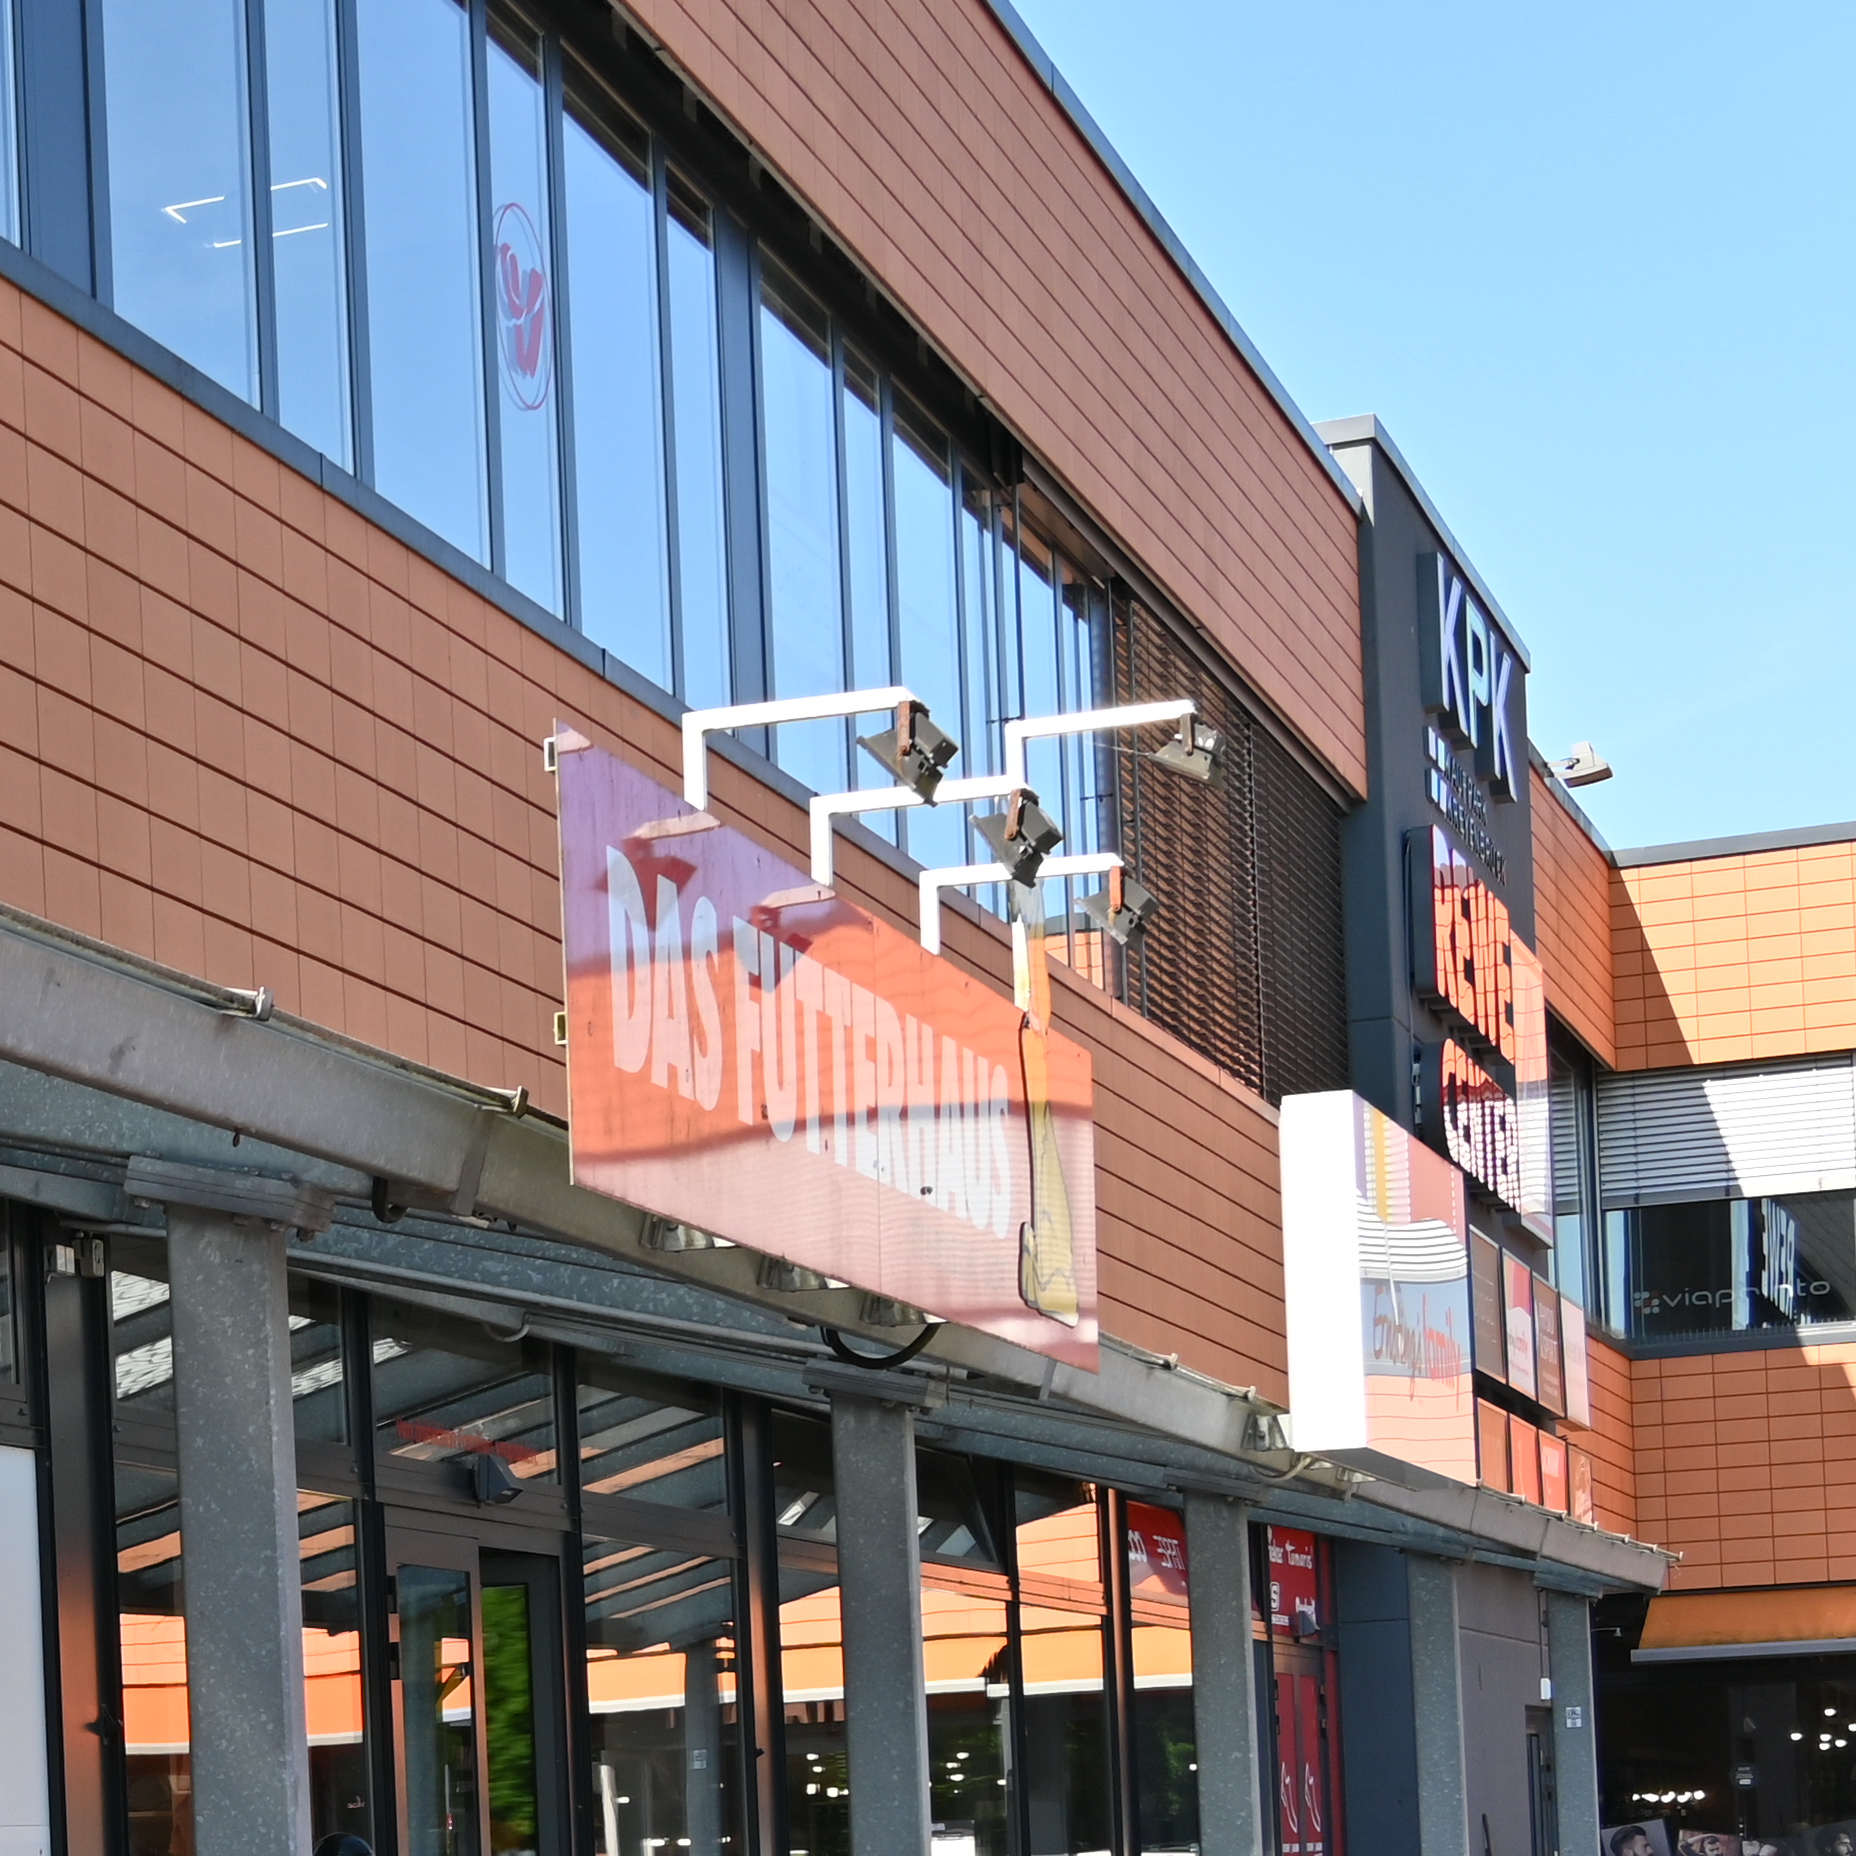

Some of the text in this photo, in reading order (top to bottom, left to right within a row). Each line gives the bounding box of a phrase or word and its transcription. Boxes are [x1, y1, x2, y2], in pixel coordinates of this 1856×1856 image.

[1434, 551, 1517, 803] KPK
[606, 844, 1011, 1240] DAS FUTTERHAUS
[1432, 823, 1515, 1066] REWE
[1442, 1037, 1520, 1214] CENTER
